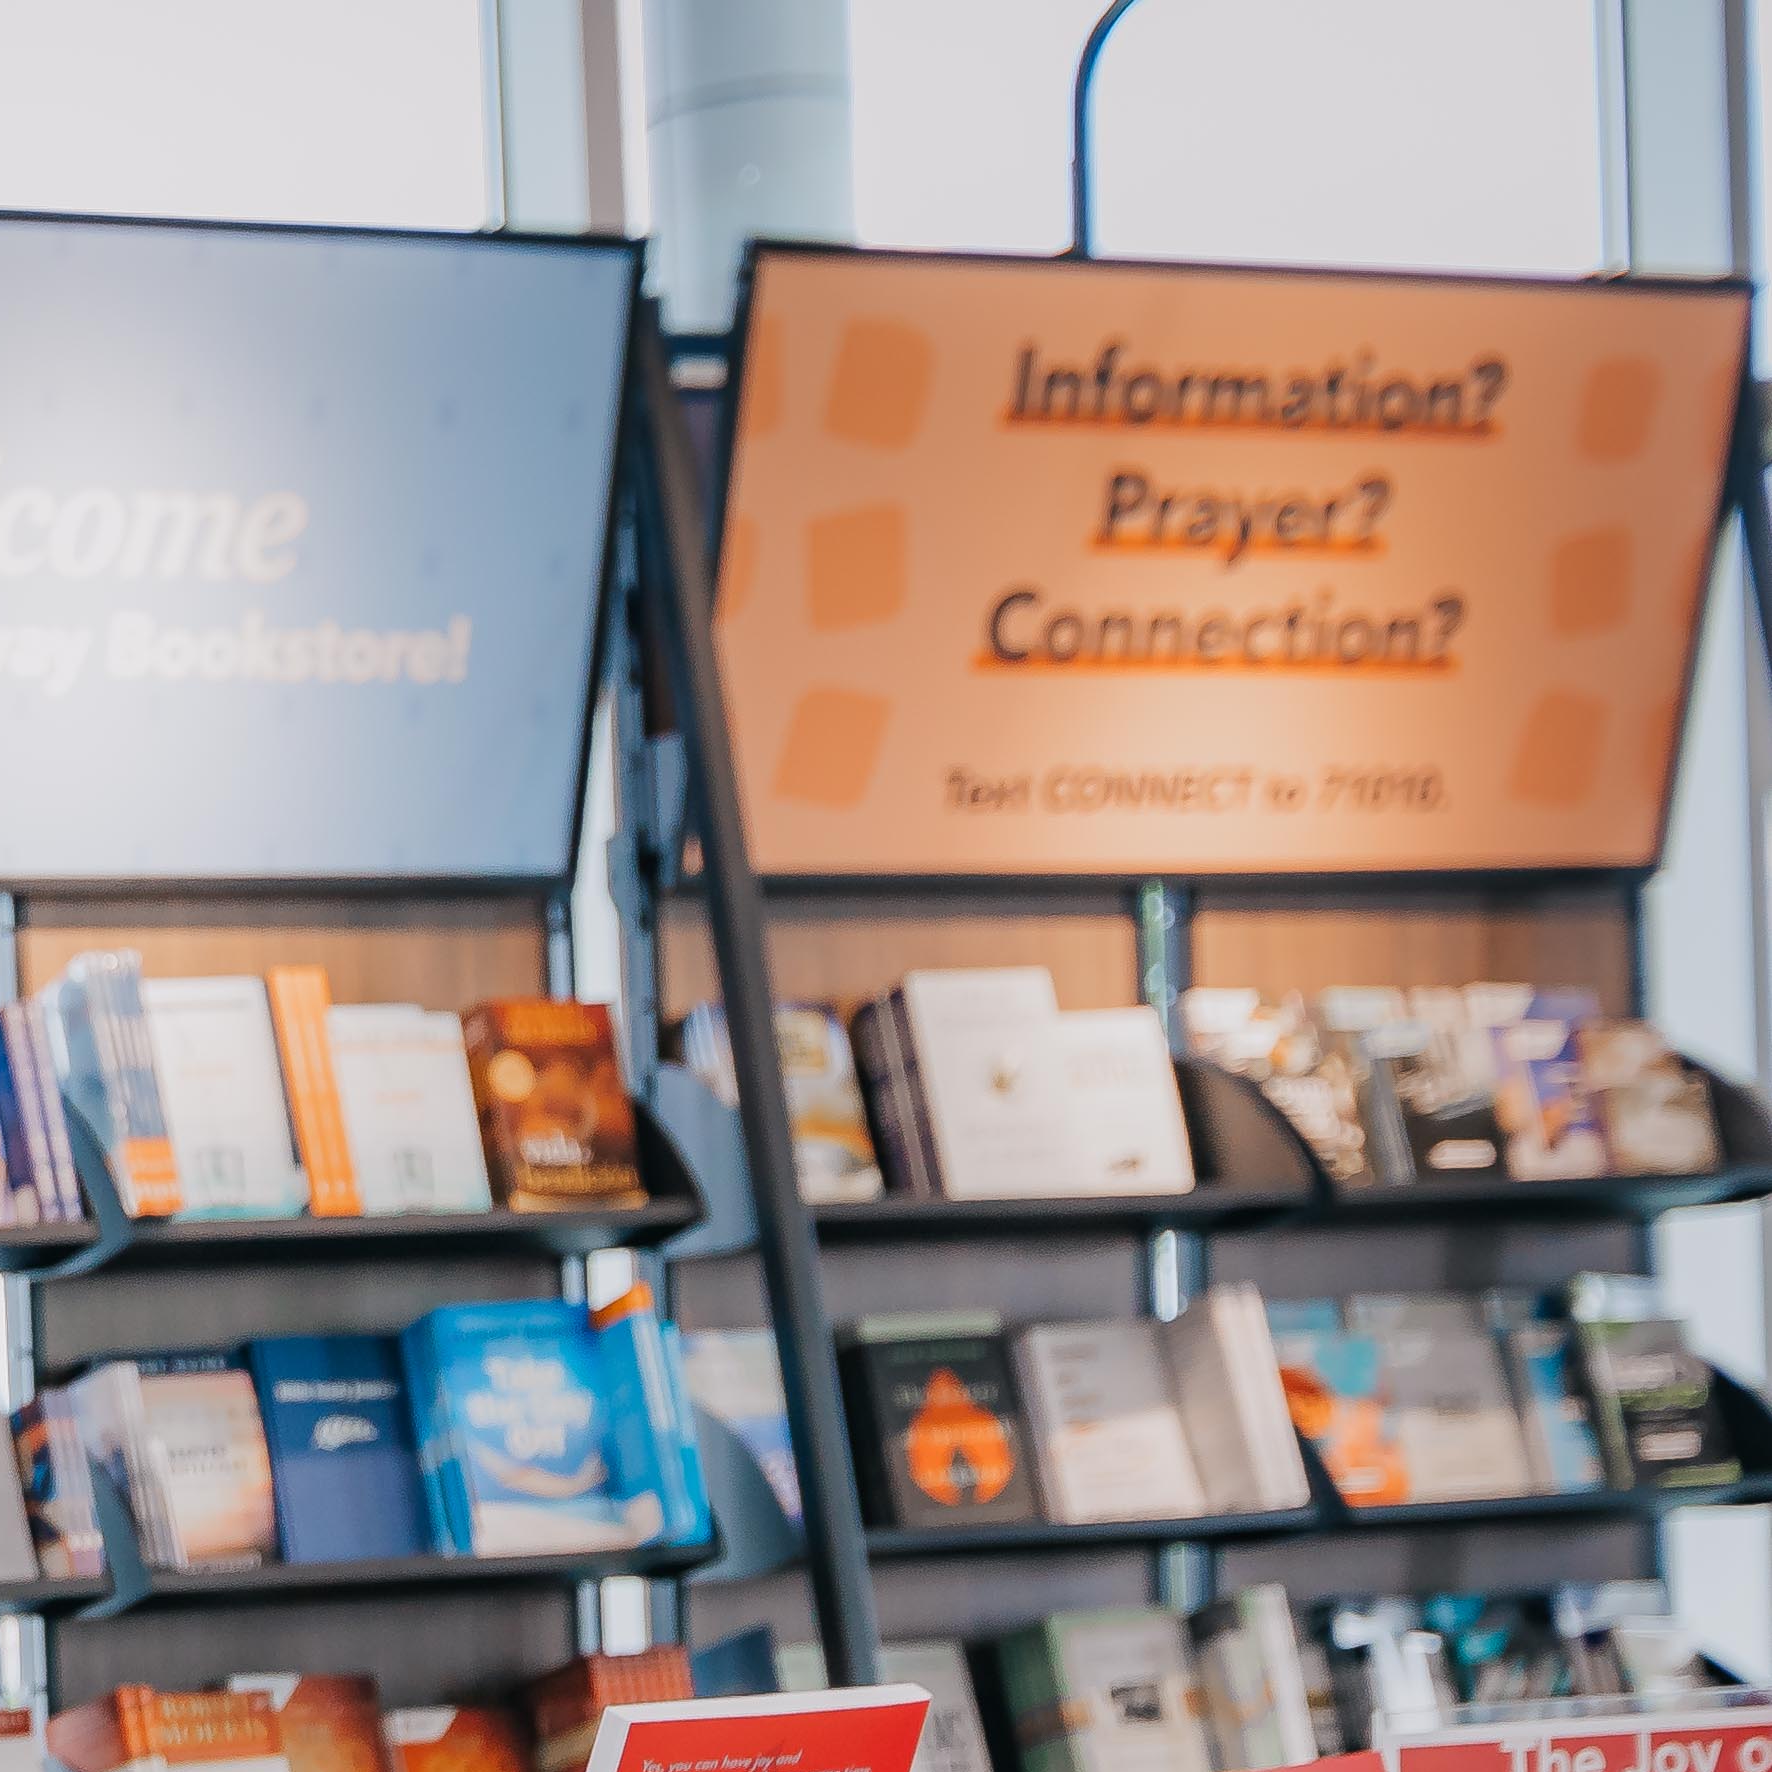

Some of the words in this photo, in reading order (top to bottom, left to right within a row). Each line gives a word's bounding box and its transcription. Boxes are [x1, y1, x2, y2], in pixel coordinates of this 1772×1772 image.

[1009, 340, 1508, 436] Information?
[1102, 470, 1391, 566] Prayer?
[106, 613, 472, 684] Bookstore!
[987, 588, 1466, 665] Connection?
[945, 764, 1032, 810] Text
[1041, 766, 1257, 813] CONNECT
[1263, 770, 1309, 810] to
[695, 1760, 718, 1770] can
[722, 1754, 751, 1770] have
[752, 1754, 774, 1772] joy
[776, 1750, 803, 1765] and
